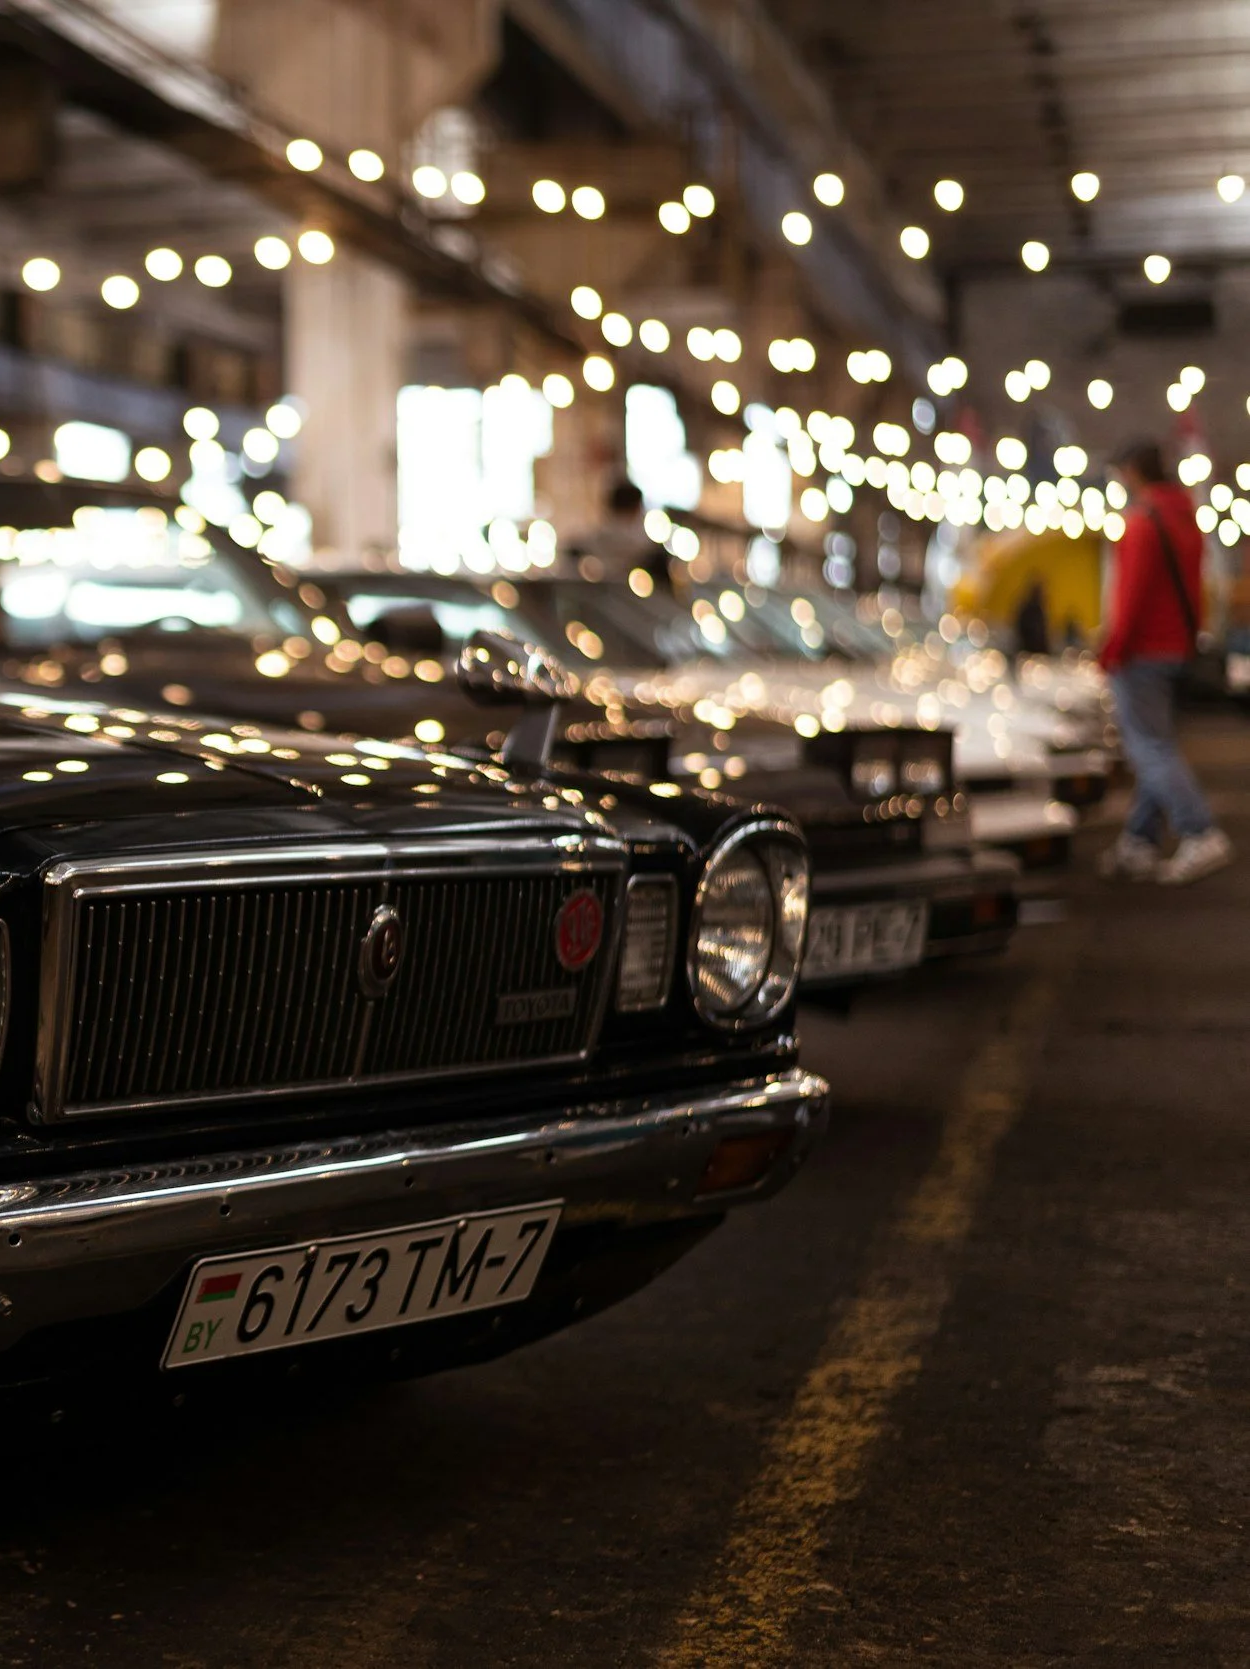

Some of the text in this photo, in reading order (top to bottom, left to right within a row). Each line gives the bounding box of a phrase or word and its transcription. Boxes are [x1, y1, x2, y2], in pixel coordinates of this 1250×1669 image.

[503, 991, 570, 1018] TOYOTA
[236, 1218, 550, 1344] 6173 TM-7
[182, 1317, 223, 1353] BY
